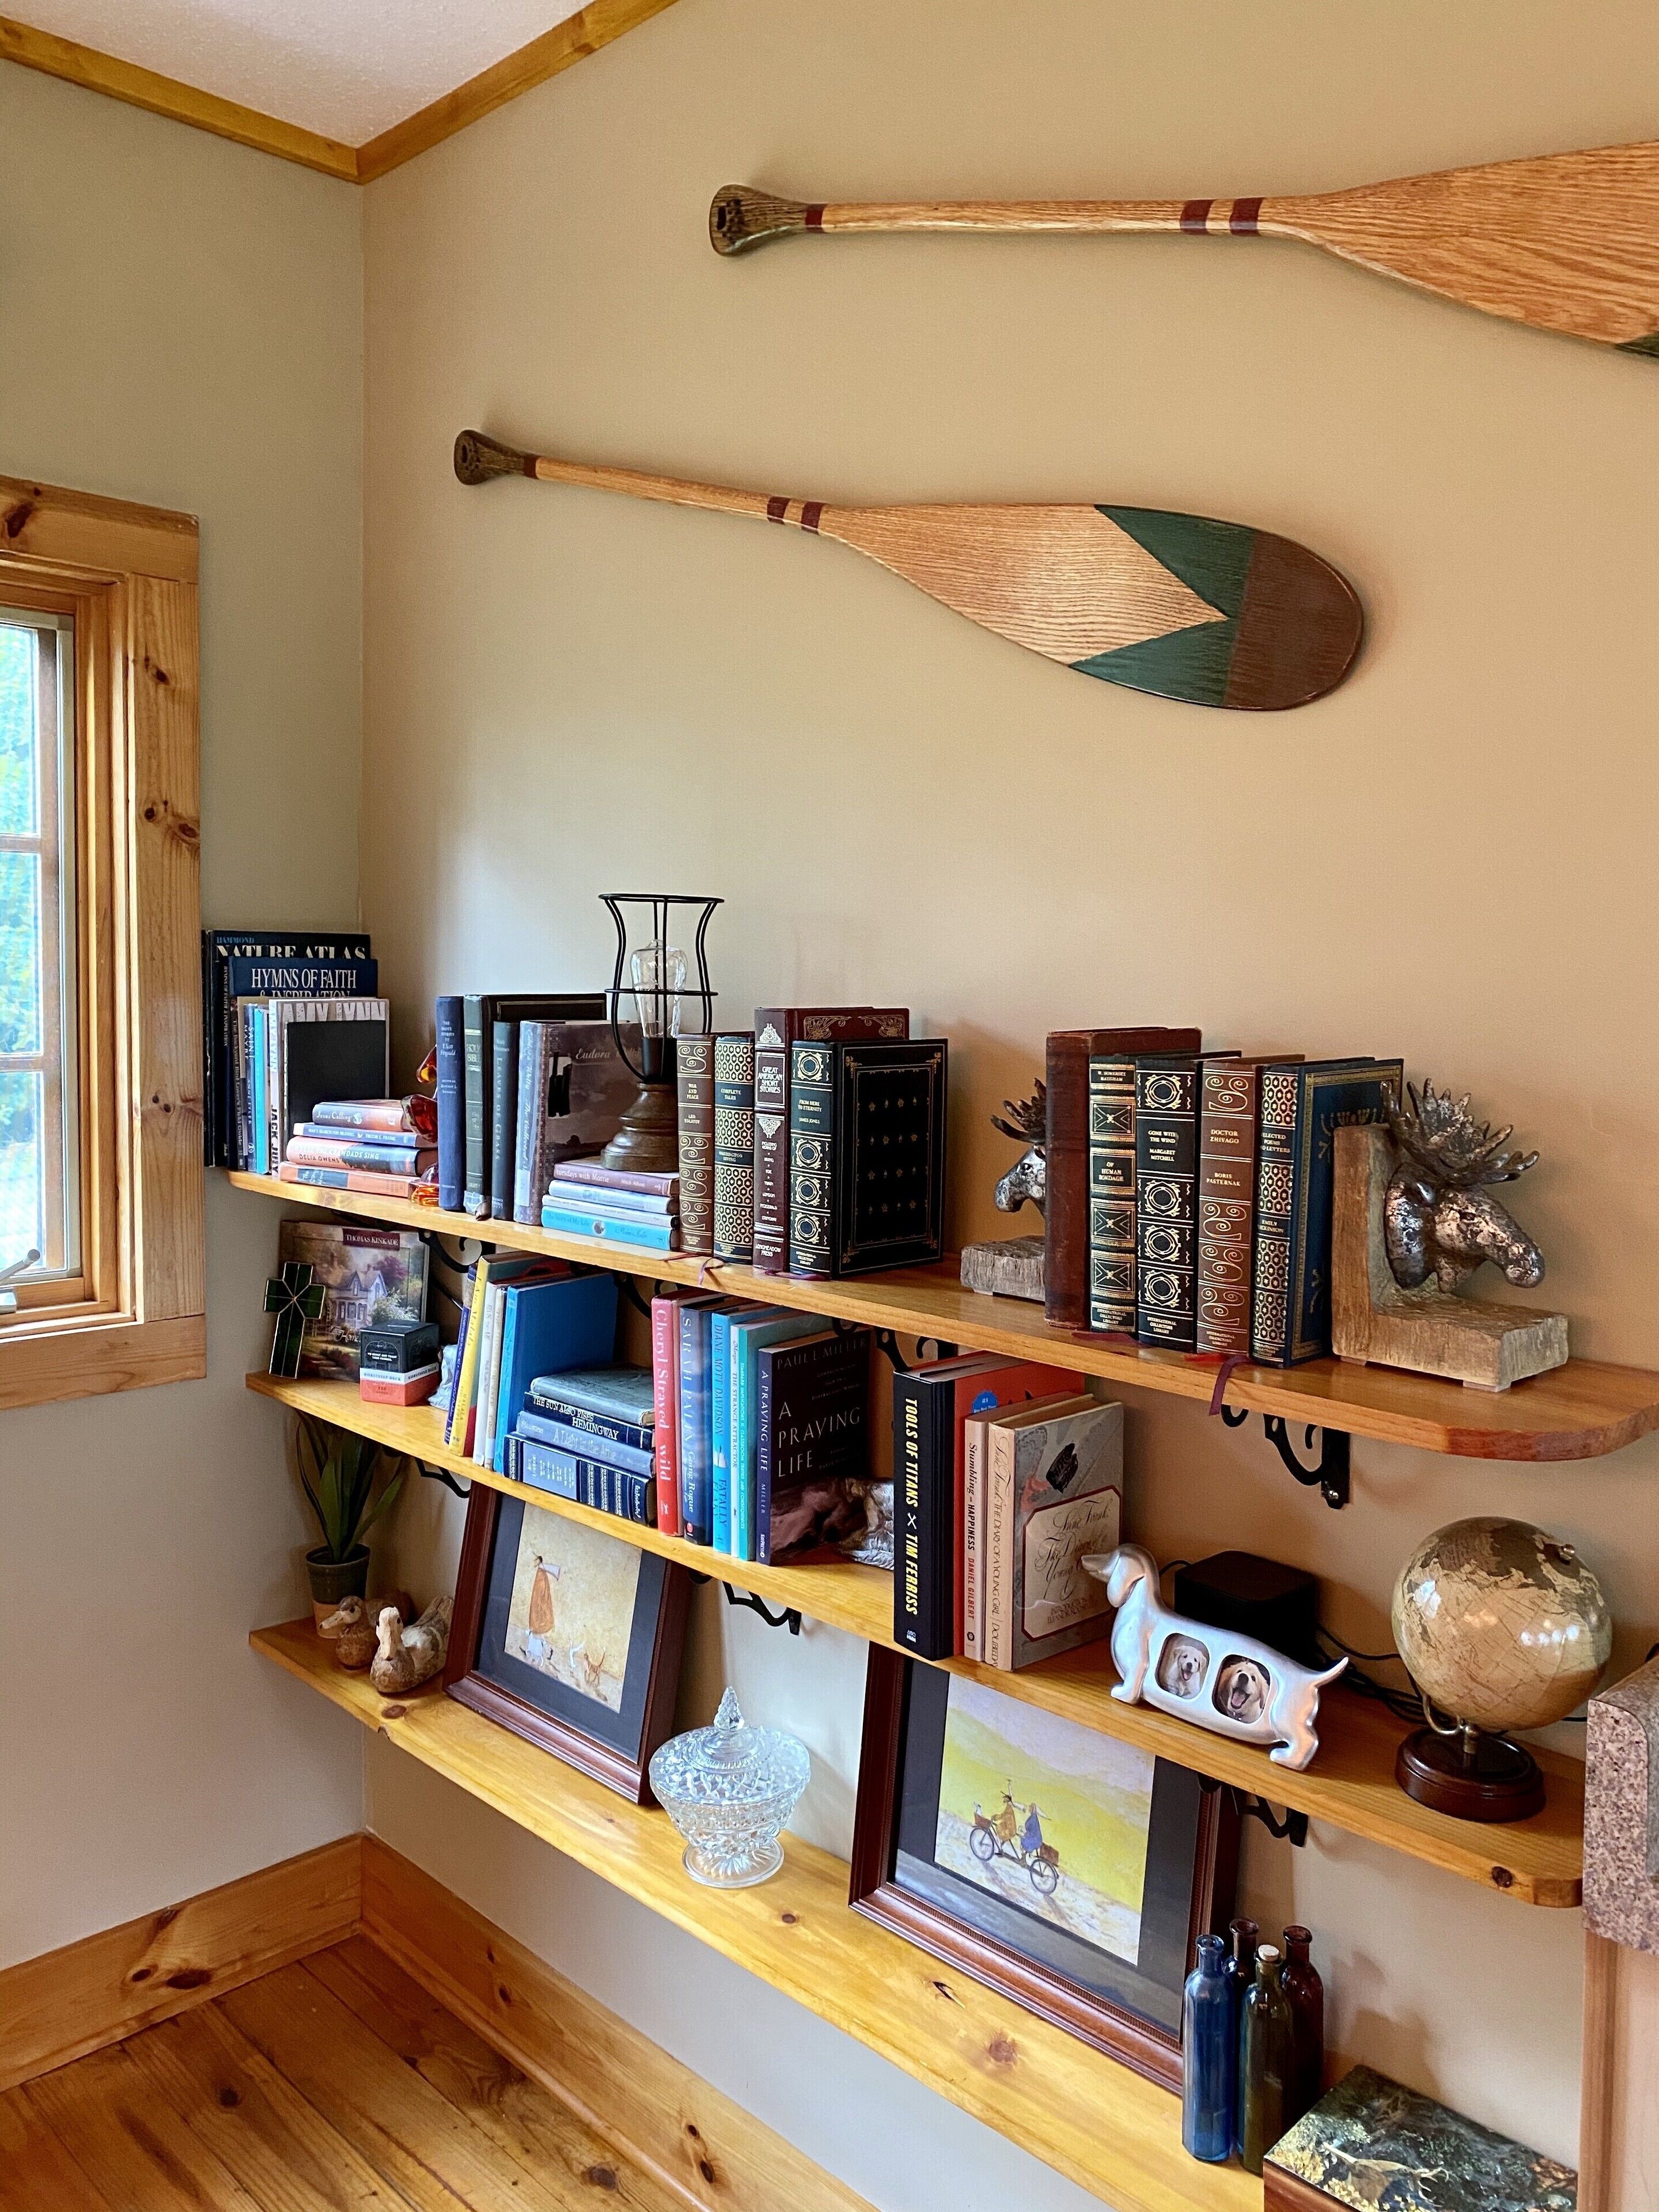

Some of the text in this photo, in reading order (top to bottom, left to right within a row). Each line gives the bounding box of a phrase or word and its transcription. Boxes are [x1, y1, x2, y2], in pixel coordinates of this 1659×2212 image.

[305, 946, 365, 960] ATLAS
[251, 968, 357, 988] HYMNS OF FAITH
[575, 1048, 611, 1059] Eudora
[757, 1073, 783, 1081] AMERICAN
[759, 1086, 781, 1094] STORIES
[331, 1111, 352, 1122] Calling
[496, 1104, 502, 1116] OF
[329, 1148, 363, 1159] CRAWDADS
[556, 1168, 610, 1183] tuesdays with Morrie
[1206, 1178, 1241, 1187] PASTERNAK
[346, 1234, 399, 1245] THOMAS KINKADE
[755, 1243, 782, 1253] LONGMEADOW
[467, 1310, 478, 1347] Malala
[1147, 1316, 1176, 1325] INTERNATIONAL
[1150, 1322, 1173, 1330] COLLECTORS
[778, 1353, 808, 1370] PAUL
[813, 1350, 820, 1361] L.
[682, 1317, 693, 1442] SARAH PALIN
[714, 1324, 724, 1436] DIANE MOTT DAVIDSON
[761, 1370, 769, 1379] A
[656, 1309, 671, 1482] Cheryl Strayed wild
[532, 1396, 594, 1422] THE SUN ALSO RISES
[760, 1385, 769, 1441] PRAYING
[778, 1401, 791, 1420] A
[571, 1416, 619, 1440] HEMINGWAY
[778, 1407, 860, 1449] PRAYING
[778, 1450, 812, 1477] LIFE
[905, 1398, 919, 1508] TOOLS OF TITANS
[967, 1442, 978, 1496] Stumbling
[686, 1451, 696, 1513] Going Rogue
[718, 1479, 728, 1526] FATALLY
[994, 1503, 1002, 1518] THE
[967, 1503, 975, 1551] HAPPINESS
[993, 1518, 1002, 1544] DIARY
[906, 1533, 918, 1557] TIM
[993, 1545, 1001, 1555] OF
[967, 1557, 975, 1585] DANIEL
[992, 1565, 1001, 1596] YOUNG
[906, 1559, 918, 1615] FERRISS
[967, 1586, 975, 1620] GILBERT
[992, 1597, 1001, 1616] GIRL
